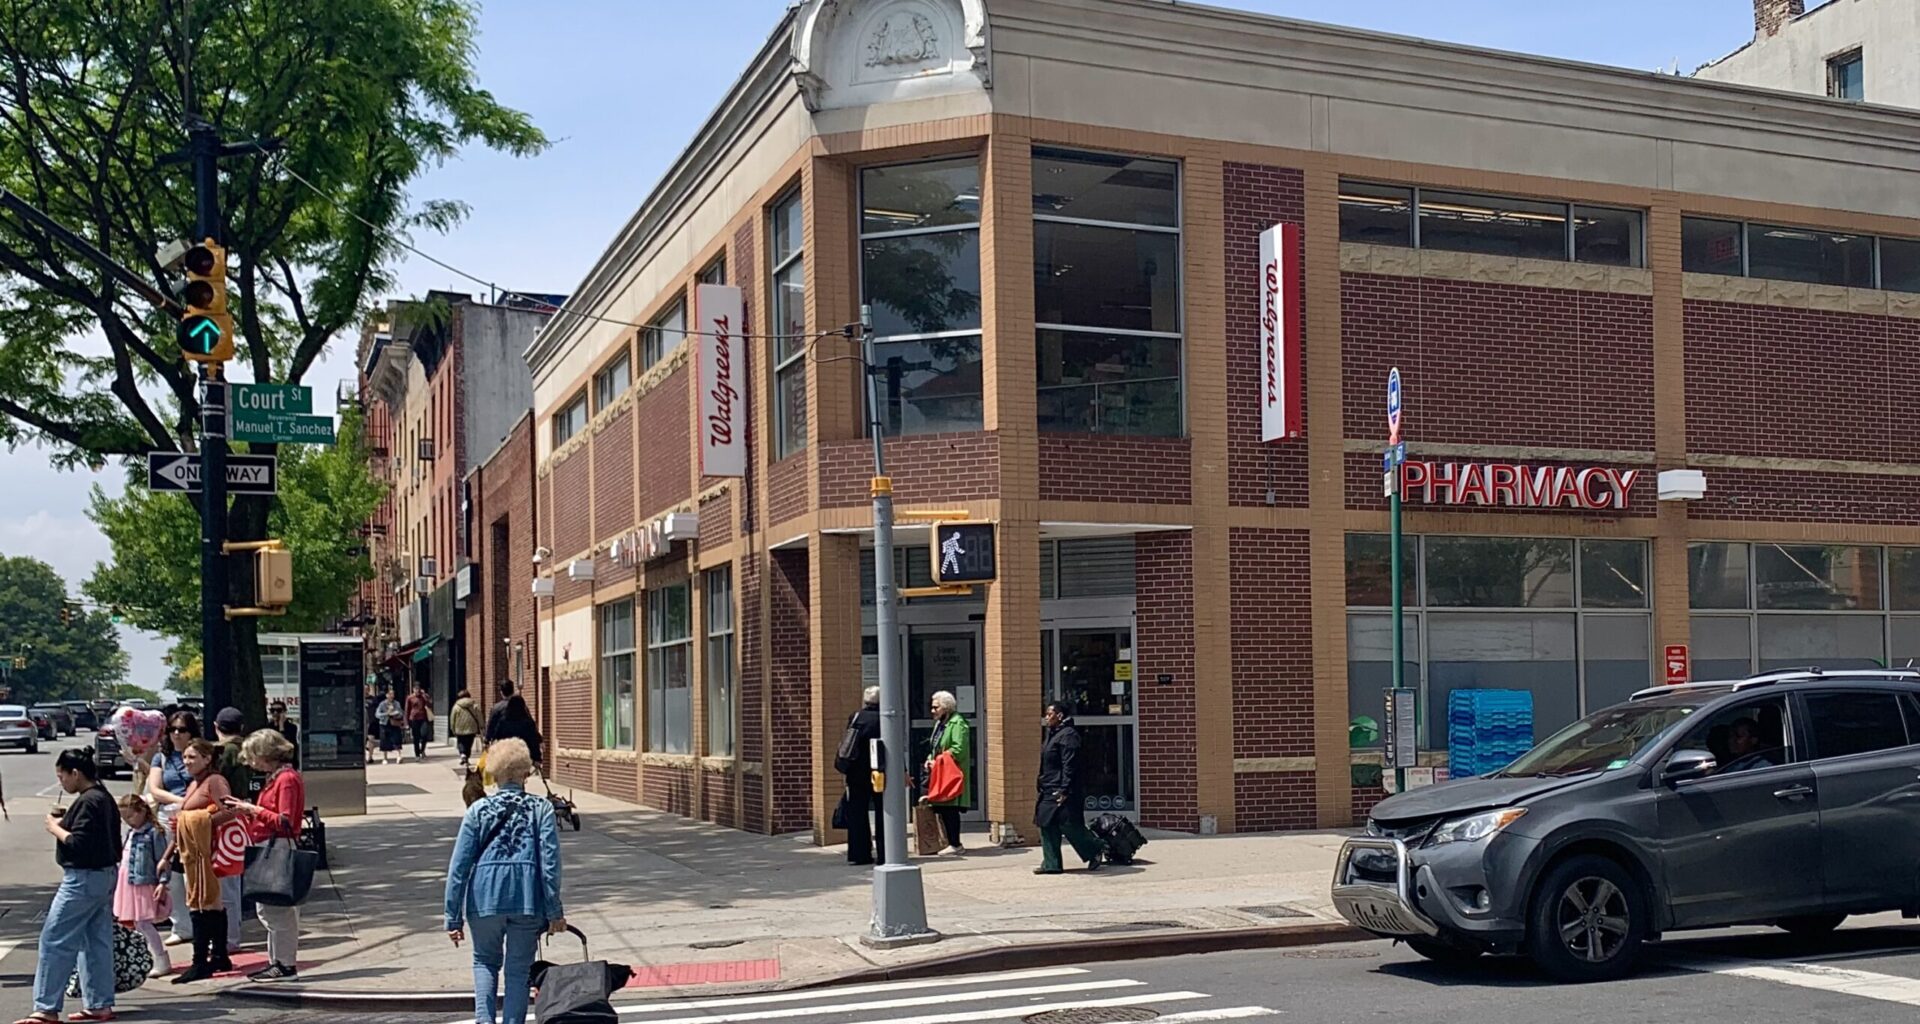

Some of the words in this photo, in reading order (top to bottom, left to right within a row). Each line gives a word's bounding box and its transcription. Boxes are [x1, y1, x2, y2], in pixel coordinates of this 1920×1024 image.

[1263, 259, 1278, 408] Walgreens
[239, 387, 285, 410] Court
[291, 387, 302, 401] St
[708, 315, 739, 447] Walgreens
[235, 420, 274, 433] Manuel
[278, 422, 286, 434] T.
[289, 422, 332, 436] Sanchez
[174, 465, 198, 480] ON
[226, 467, 262, 481] WAY
[1401, 461, 1639, 510] PHARMACY
